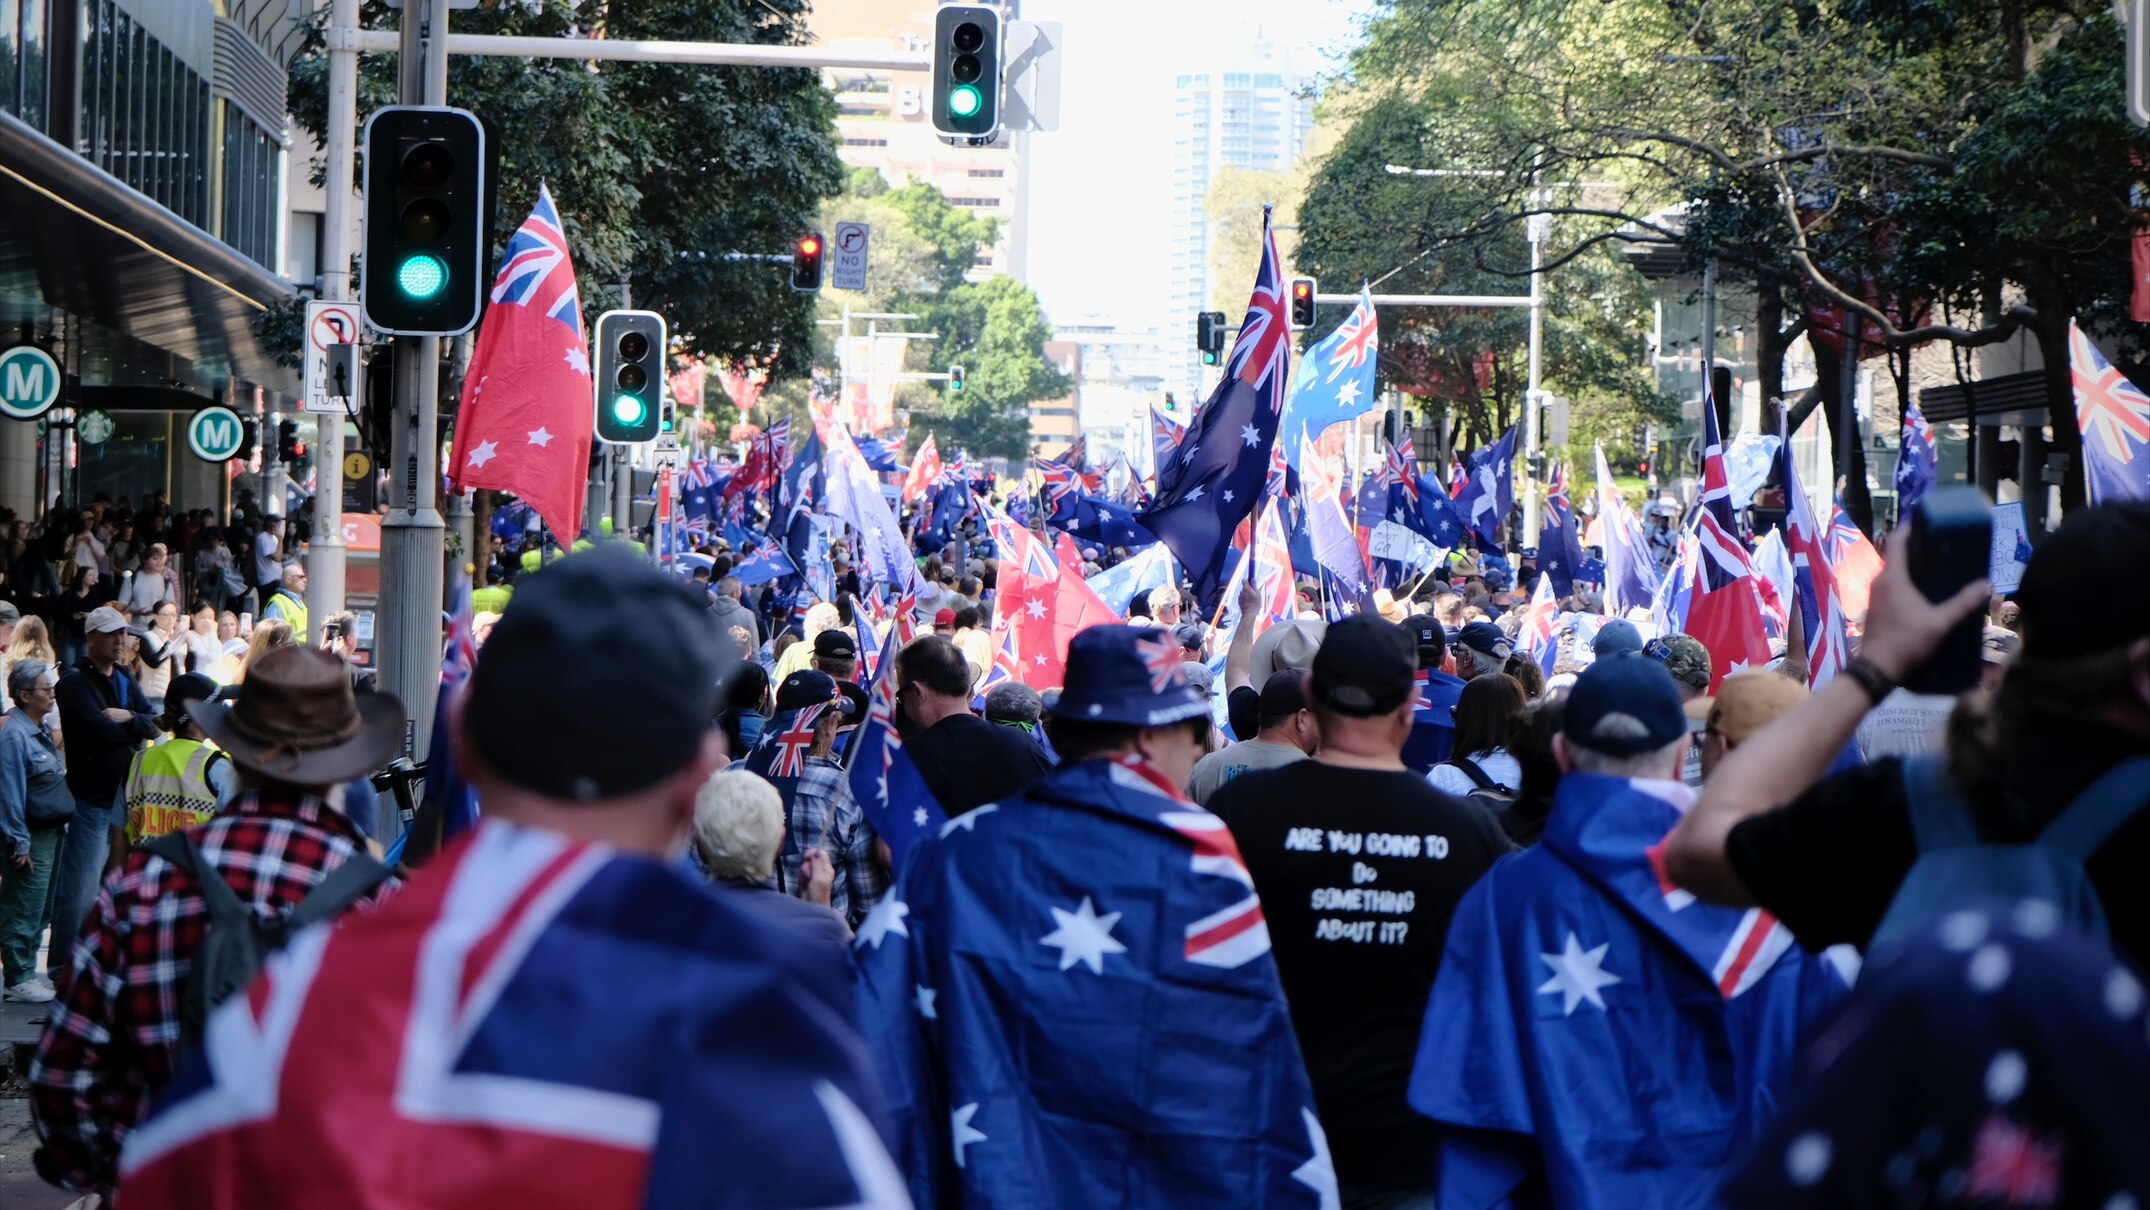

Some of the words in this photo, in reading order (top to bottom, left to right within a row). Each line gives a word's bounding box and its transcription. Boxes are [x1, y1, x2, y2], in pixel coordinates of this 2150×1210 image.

[836, 267, 862, 276] RIGHT
[841, 256, 859, 266] NO
[837, 277, 861, 285] TURN
[6, 362, 44, 401] M
[203, 419, 230, 449] M
[1877, 718, 1891, 726] LOS
[1893, 717, 1927, 726] ANGELES
[1284, 827, 1324, 851] ARE
[1365, 832, 1421, 858] GOING
[1424, 835, 1449, 859] TO
[1311, 887, 1416, 914] SOMETHING
[1379, 921, 1409, 945] IT?
